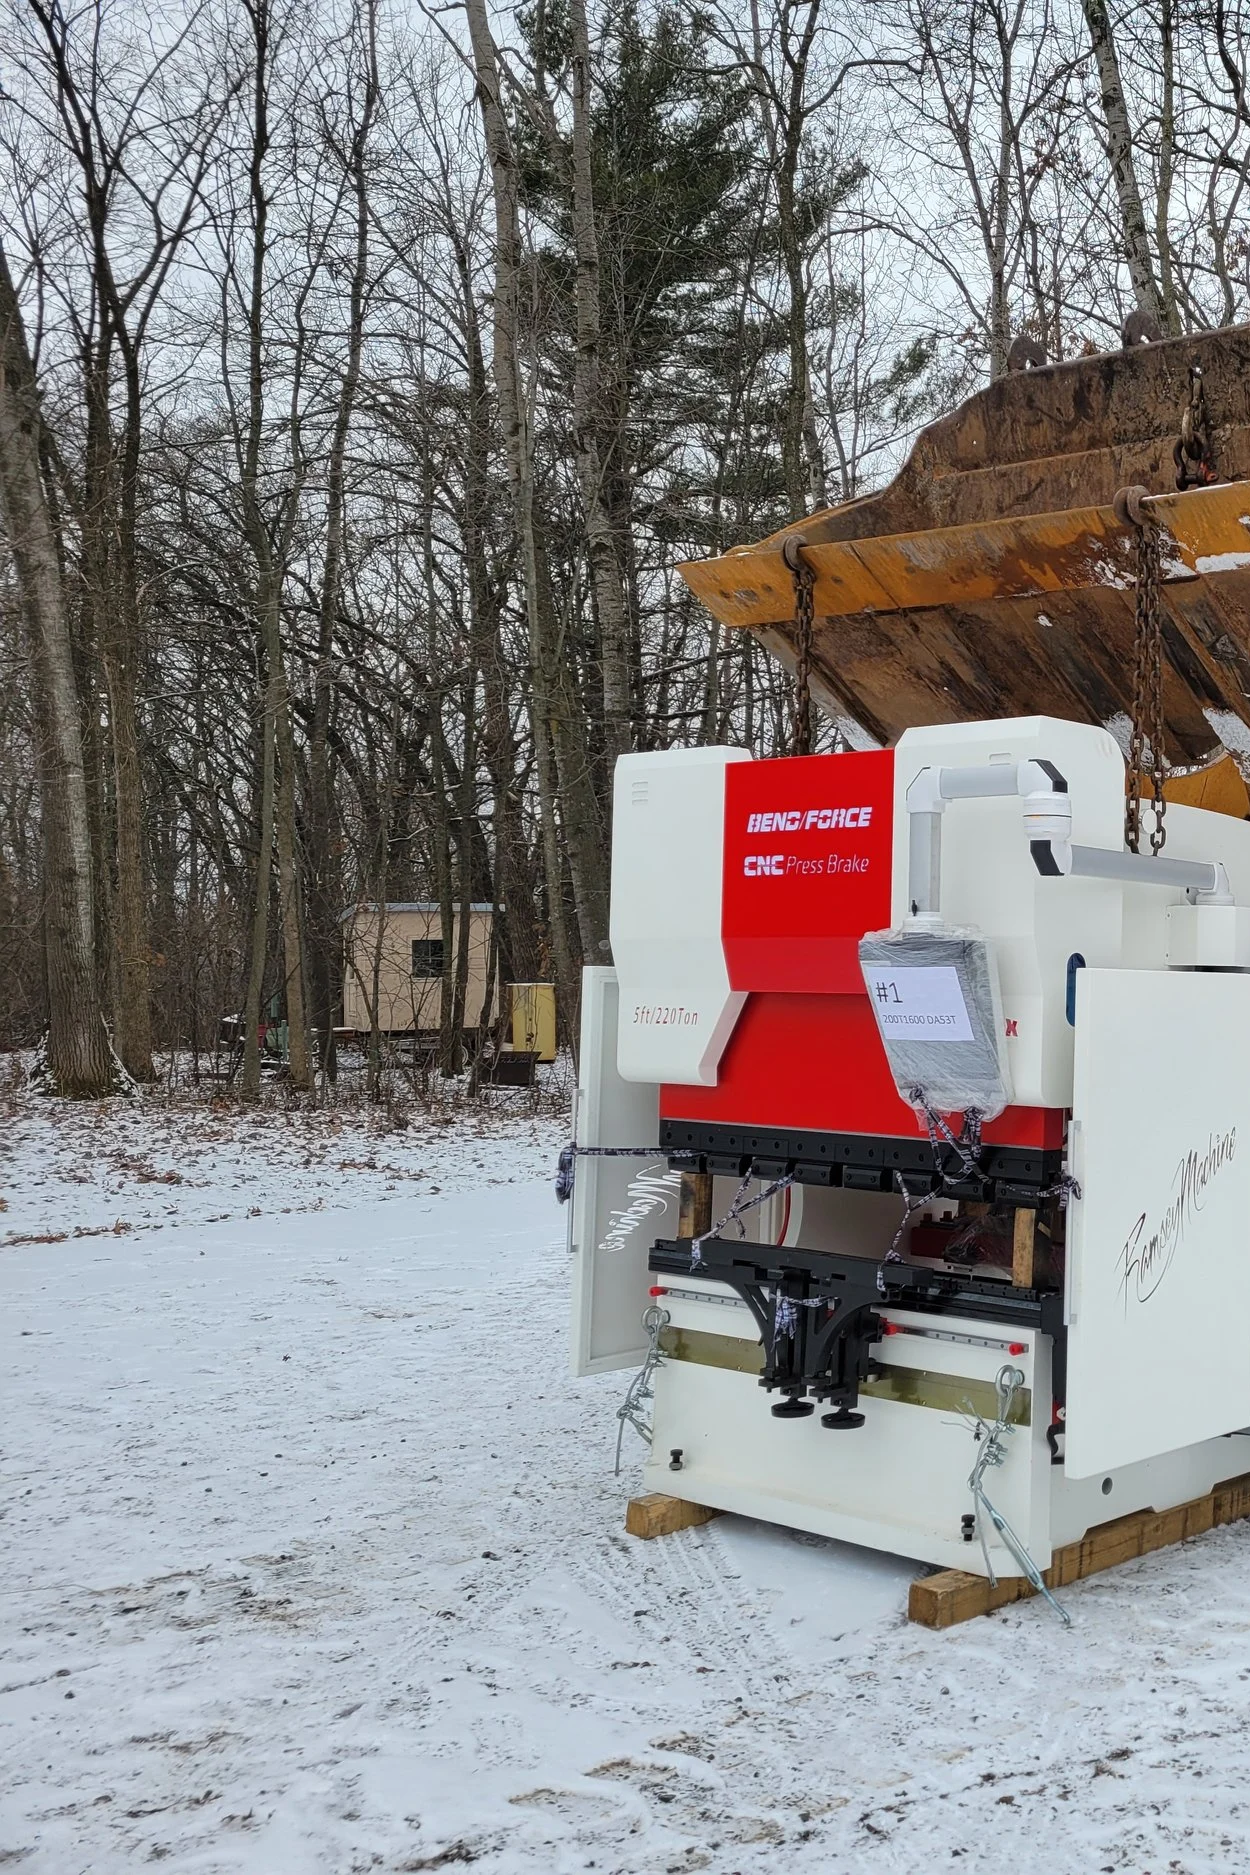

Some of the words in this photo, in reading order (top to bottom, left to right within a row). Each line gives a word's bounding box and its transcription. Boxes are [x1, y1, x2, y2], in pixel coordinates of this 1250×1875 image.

[747, 806, 873, 833] BEND/FORCE
[744, 855, 784, 876] CNC
[786, 855, 824, 875] Press
[827, 854, 869, 874] Brake
[875, 981, 903, 1004] #1
[927, 1015, 956, 1025] DA53T
